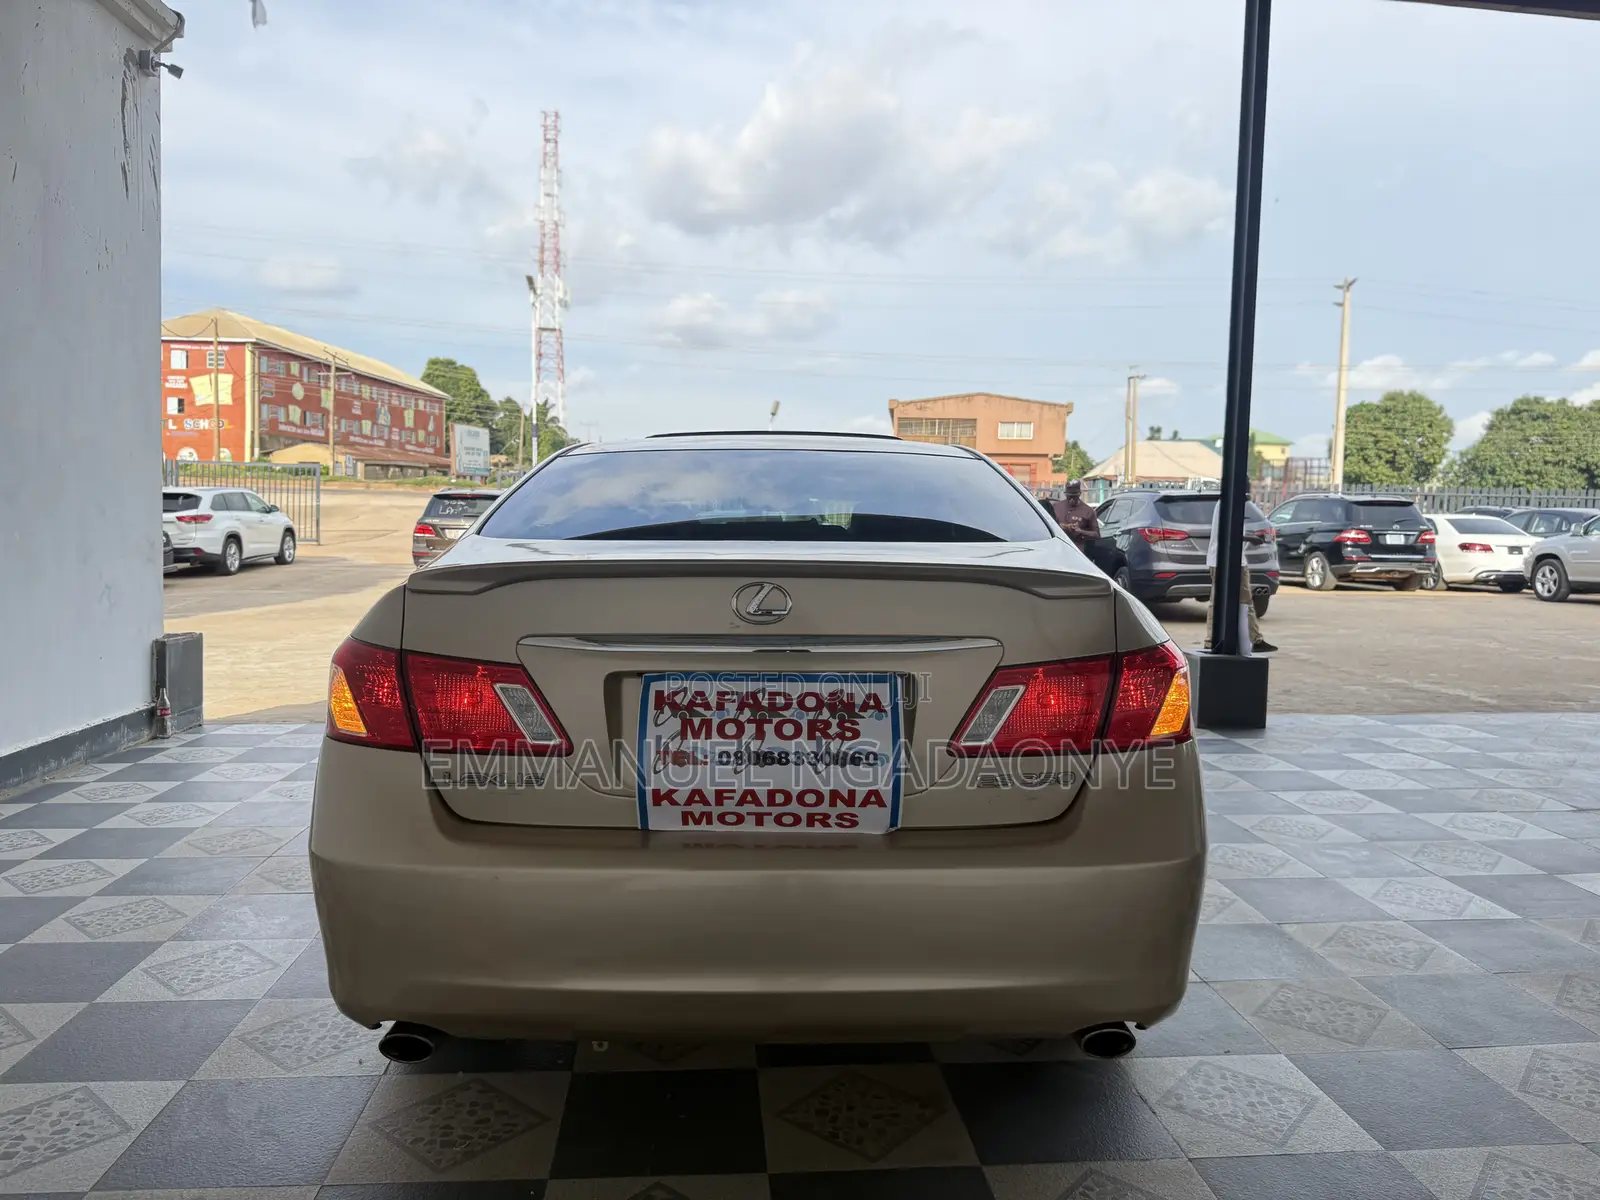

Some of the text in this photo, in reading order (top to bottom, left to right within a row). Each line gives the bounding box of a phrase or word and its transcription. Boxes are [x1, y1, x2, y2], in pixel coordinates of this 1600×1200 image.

[183, 418, 235, 431] SCHOOL
[653, 690, 888, 713] KAFADONA
[680, 718, 861, 741] MOTORS
[652, 788, 887, 808] KAFADONA
[681, 811, 860, 829] MOTORS
